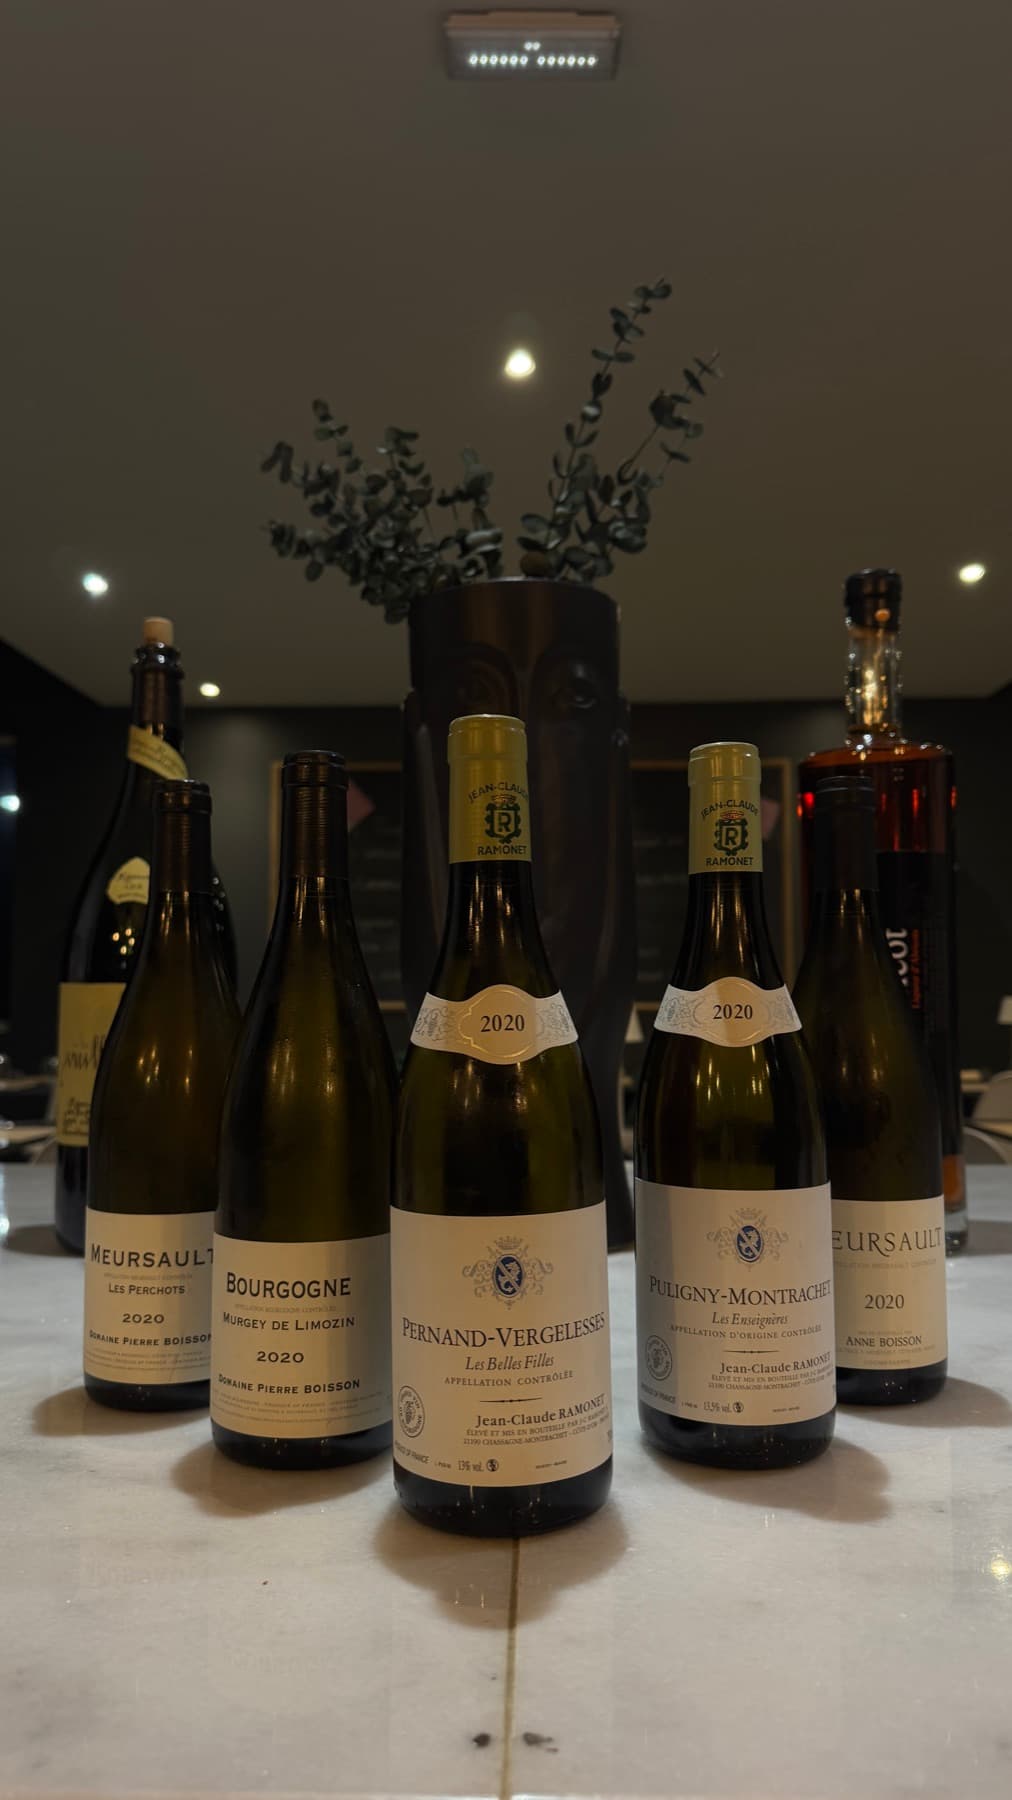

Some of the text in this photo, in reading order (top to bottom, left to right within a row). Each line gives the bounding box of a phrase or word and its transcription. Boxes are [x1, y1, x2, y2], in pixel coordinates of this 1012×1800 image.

[725, 828, 738, 845] R
[478, 845, 527, 856] RAMONET
[706, 856, 753, 867] RAMONET
[713, 1004, 753, 1020] 2020
[481, 1014, 525, 1033] 2020
[832, 1227, 941, 1257] EURSAULT
[91, 1243, 213, 1268] MEURSAULT
[109, 1283, 185, 1295] LES PERCHOTS
[226, 1272, 351, 1298] BOURGOGNE
[649, 1275, 831, 1305] PULIGNY-MONTRACHET
[864, 1294, 905, 1309] 2020
[122, 1313, 165, 1324] 2020
[223, 1312, 355, 1331] MURGEY DE LIMOZIN
[712, 1312, 788, 1329] Les Enseignères
[89, 1329, 120, 1344] DOMAINE
[123, 1336, 159, 1346] PIERRE
[402, 1311, 605, 1348] PERNAND-VERGELESSES
[669, 1324, 726, 1339] APPELLATION
[730, 1330, 778, 1339] D'ORIGINE
[846, 1335, 922, 1347] ANNE BOISSON
[256, 1351, 304, 1363] 2020
[465, 1353, 554, 1371] Les Belles Filles
[720, 1352, 831, 1374] Jean-Claude RAMONET
[218, 1374, 360, 1394] DOMAINE PIERRE BOISSON
[444, 1370, 574, 1387] APPELLATION CONTRÔLÉE
[475, 1411, 556, 1428] Jean-Claude
[559, 1394, 605, 1420] RAMONET
